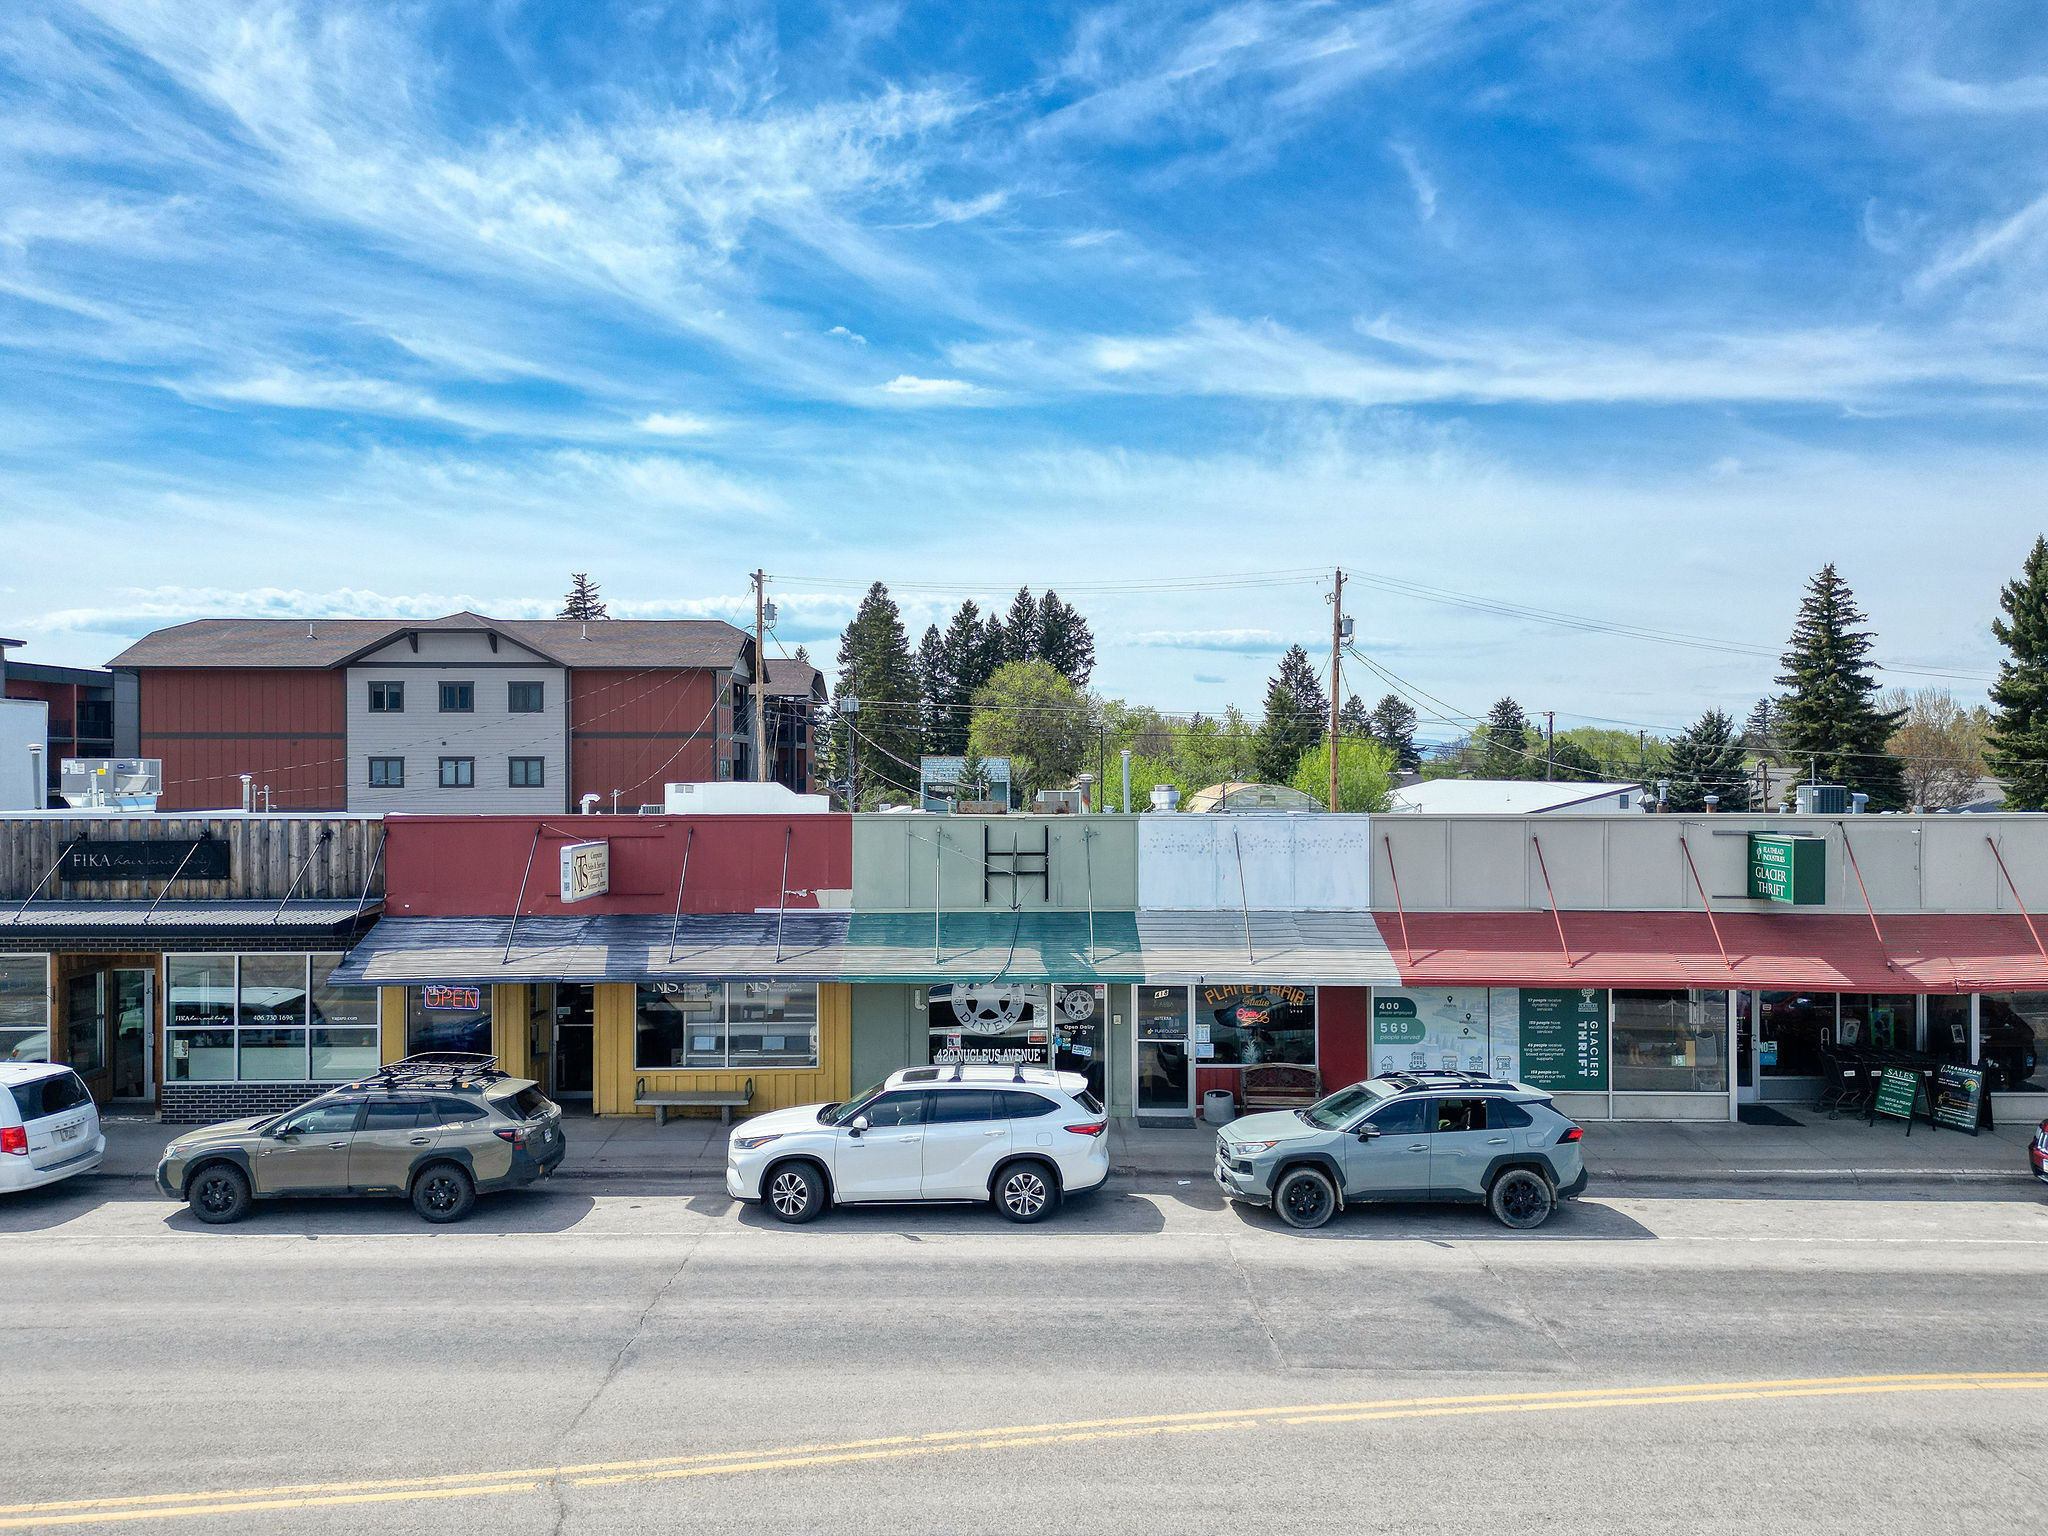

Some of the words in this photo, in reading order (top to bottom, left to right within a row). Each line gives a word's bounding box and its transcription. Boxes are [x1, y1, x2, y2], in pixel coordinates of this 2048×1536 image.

[73, 853, 111, 867] FIKA
[1755, 866, 1788, 883] GLACIER
[1757, 880, 1786, 897] THRIFT
[427, 989, 478, 1008] OPEN
[1242, 995, 1270, 1007] Studio
[1379, 1002, 1400, 1010] 400
[960, 1012, 1017, 1033] DINER
[1380, 1022, 1408, 1033] 569
[936, 1048, 955, 1062] 420
[958, 1048, 1001, 1062] NUCLEUS
[1003, 1048, 1041, 1062] AVENUE
[1578, 1020, 1588, 1077] THRIFT
[1589, 1020, 1599, 1077] GLACIER
[1887, 1068, 1914, 1080] SALES
[1947, 1064, 1982, 1076] TRANSFORM
